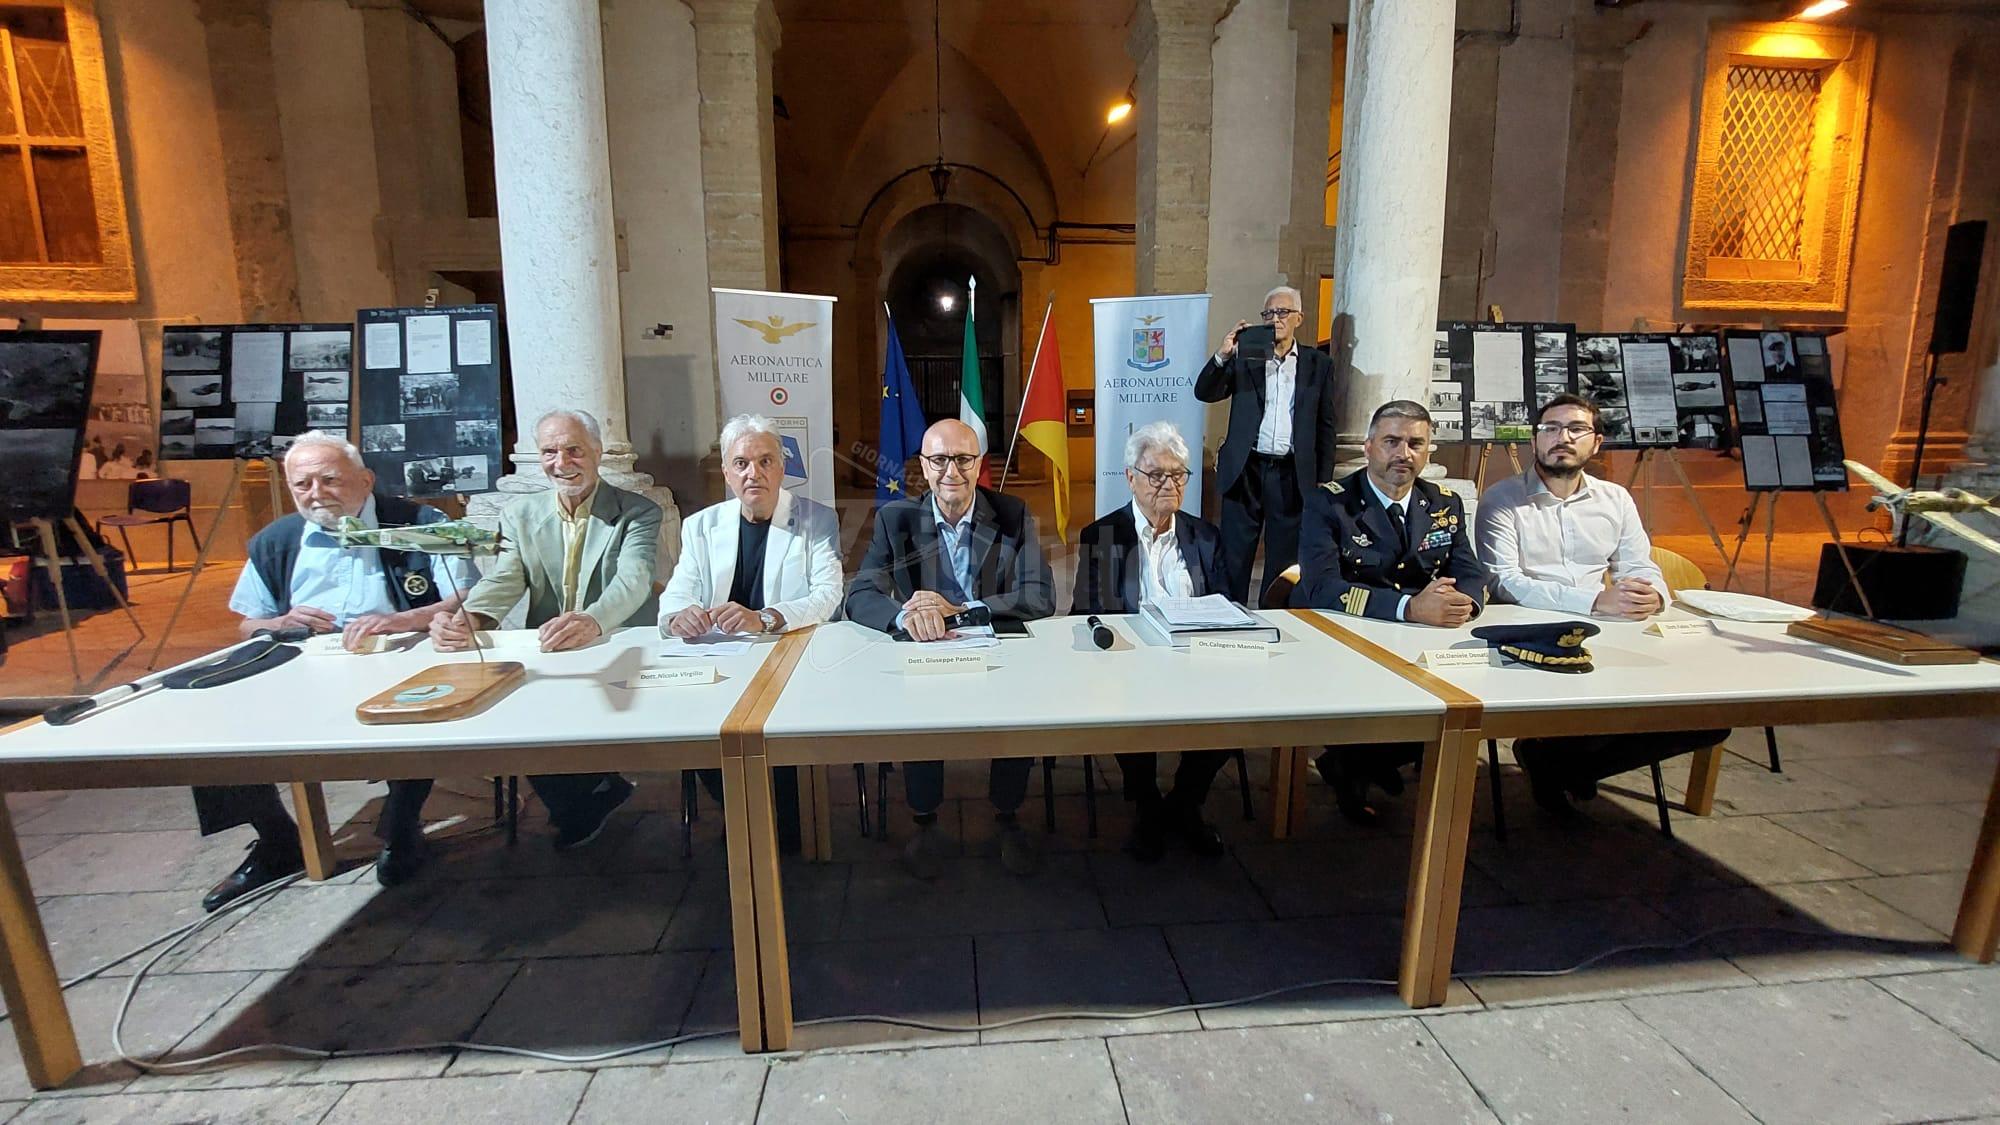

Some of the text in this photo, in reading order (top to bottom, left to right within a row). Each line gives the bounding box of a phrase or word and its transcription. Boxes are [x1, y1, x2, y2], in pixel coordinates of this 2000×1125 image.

[730, 354, 824, 368] AERONAUTICA
[747, 371, 809, 383] MILITARE
[1104, 376, 1193, 389] AERONAUTICA
[1119, 392, 1178, 403] MILITARE
[775, 419, 806, 427] TORMO
[925, 656, 954, 664] Giuseppe
[955, 655, 981, 663] Pantano
